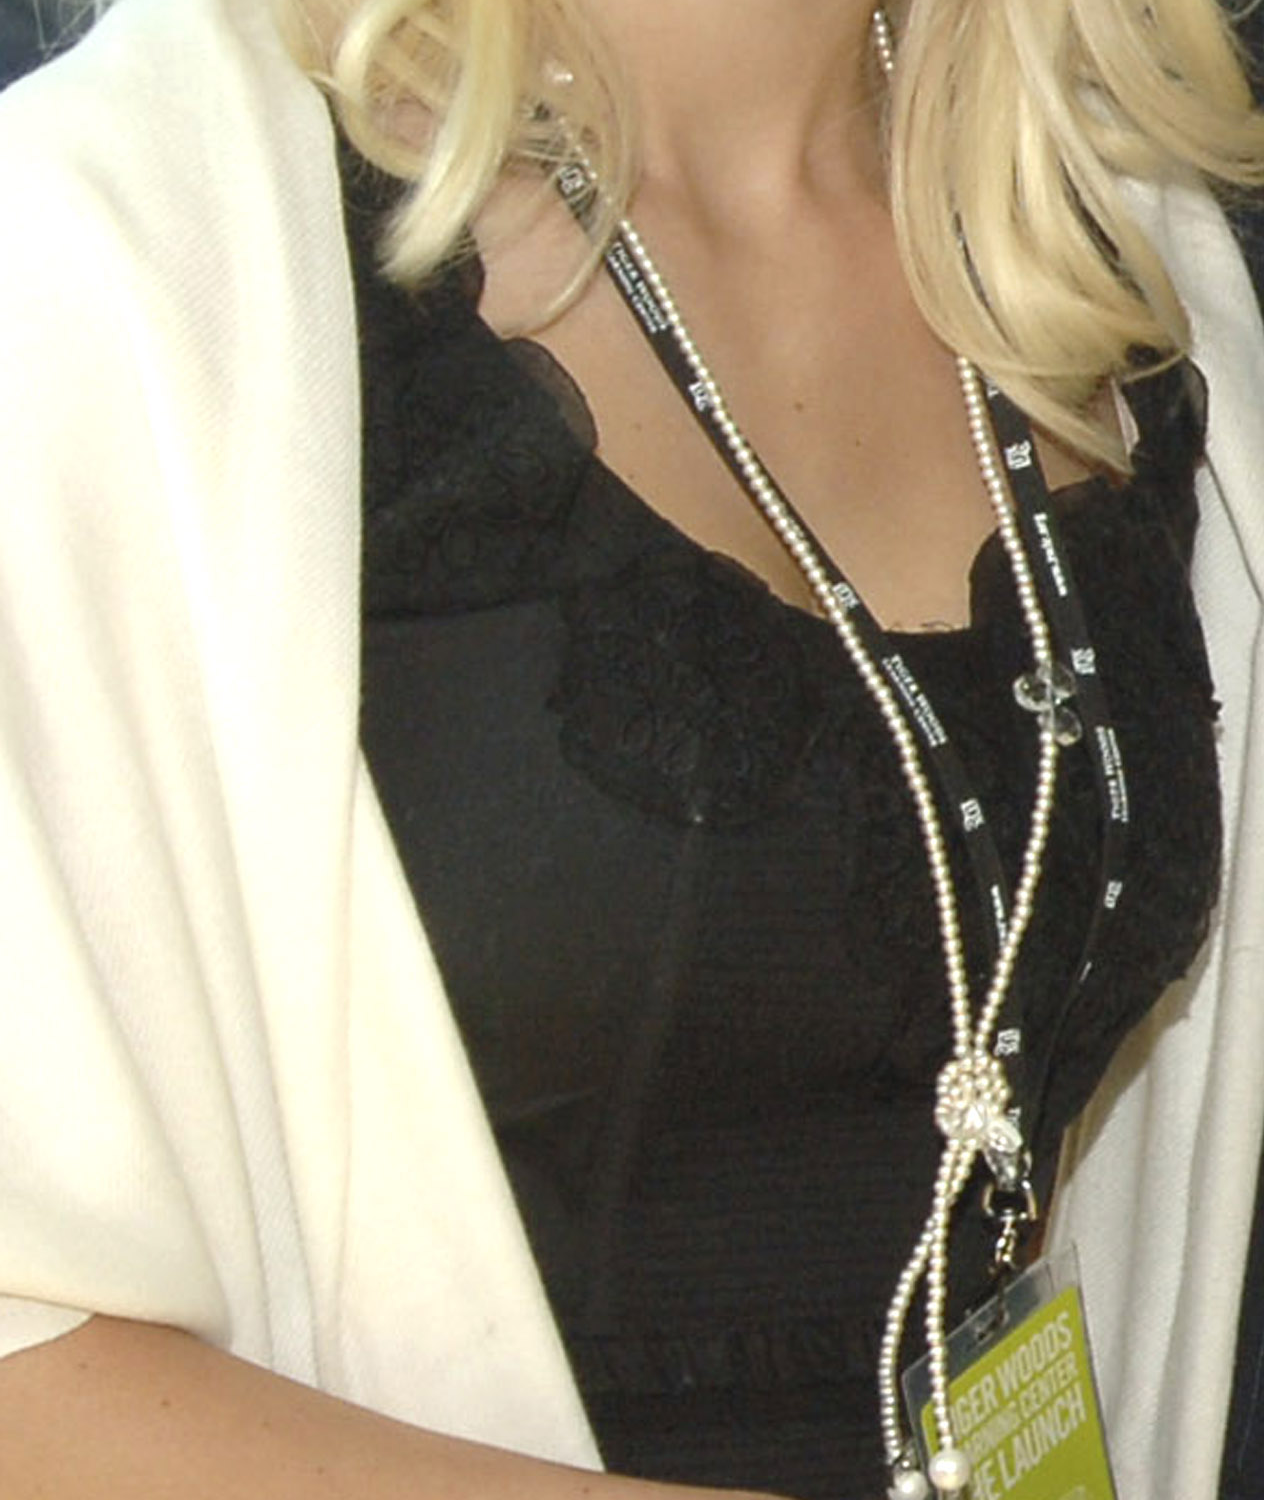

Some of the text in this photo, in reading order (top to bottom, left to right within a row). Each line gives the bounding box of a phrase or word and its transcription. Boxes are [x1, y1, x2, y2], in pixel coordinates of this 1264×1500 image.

[949, 1378, 998, 1442] IGER
[996, 1311, 1073, 1398] WOODS
[1018, 1351, 1079, 1419] CENTER
[998, 1380, 1087, 1490] LAUNCH
